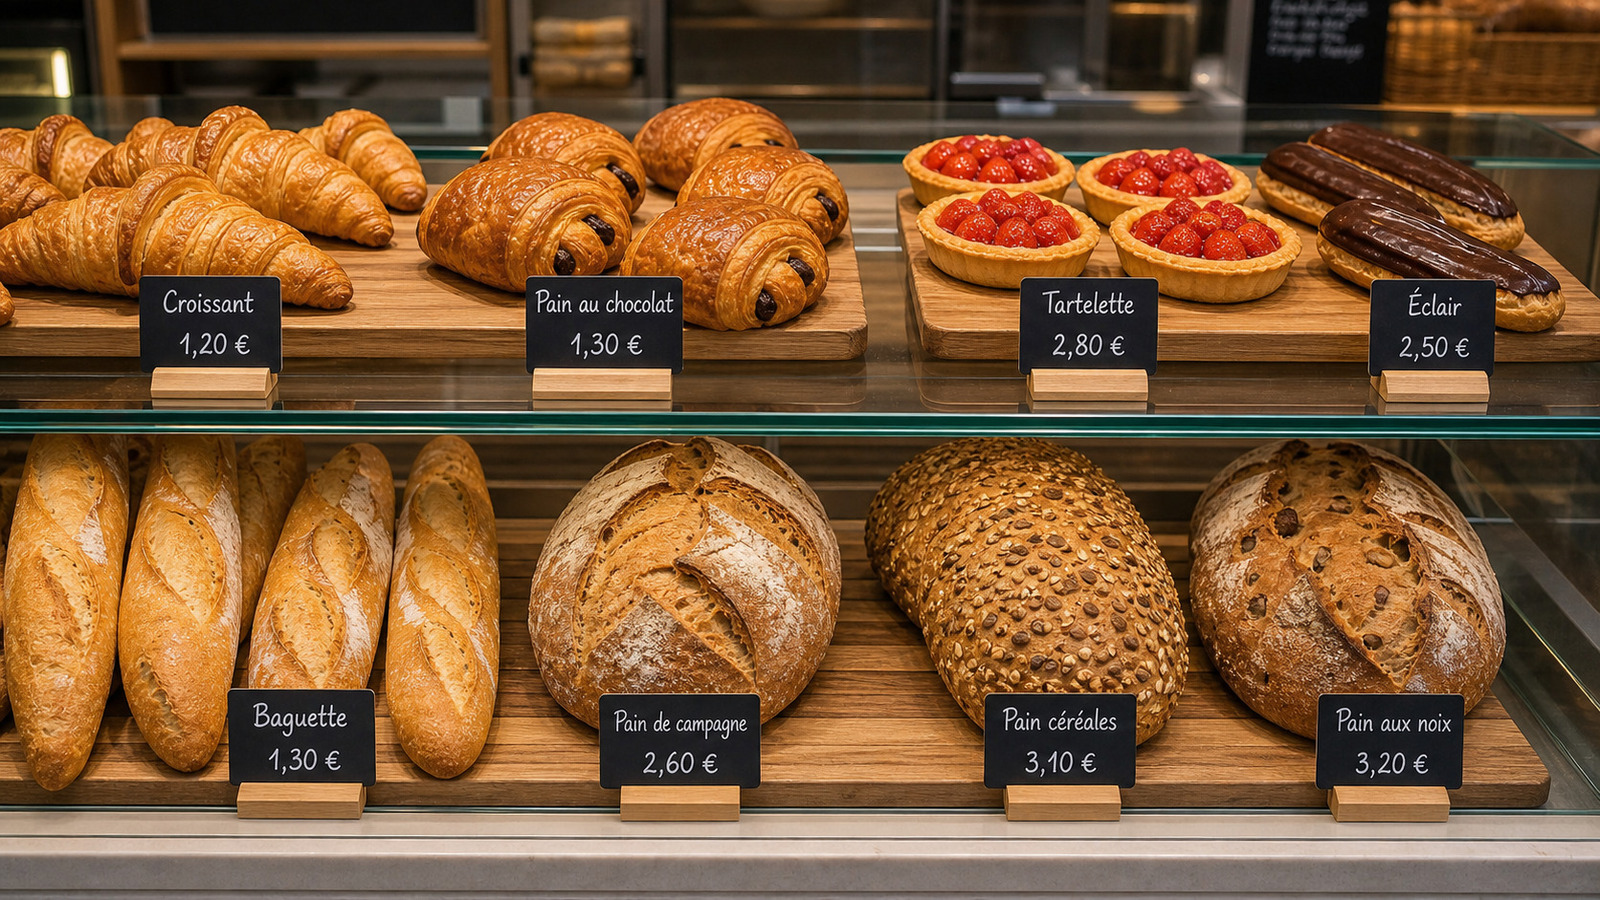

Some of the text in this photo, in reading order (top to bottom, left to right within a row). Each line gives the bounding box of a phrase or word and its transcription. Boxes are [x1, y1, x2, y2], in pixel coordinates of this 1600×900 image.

[163, 289, 255, 314] Croissant
[535, 288, 674, 314] Pain au chocolat
[1041, 290, 1135, 315] Tartelette
[1408, 286, 1463, 317] Éclair
[179, 332, 251, 360] 1,20 €
[570, 332, 643, 360] 1,30 €
[1052, 333, 1125, 361] 2,80 €
[1399, 335, 1470, 363] 2,50 €
[252, 702, 348, 738] Baguette
[613, 709, 748, 740] Pain de campagne
[1002, 706, 1117, 731] Pain céréales
[1335, 707, 1452, 733] Pain aux noix
[268, 748, 342, 775] 1,30 €
[642, 751, 719, 779] 2,60 €
[1025, 750, 1097, 778] 3,10 €
[1355, 751, 1429, 779] 3,20 €
